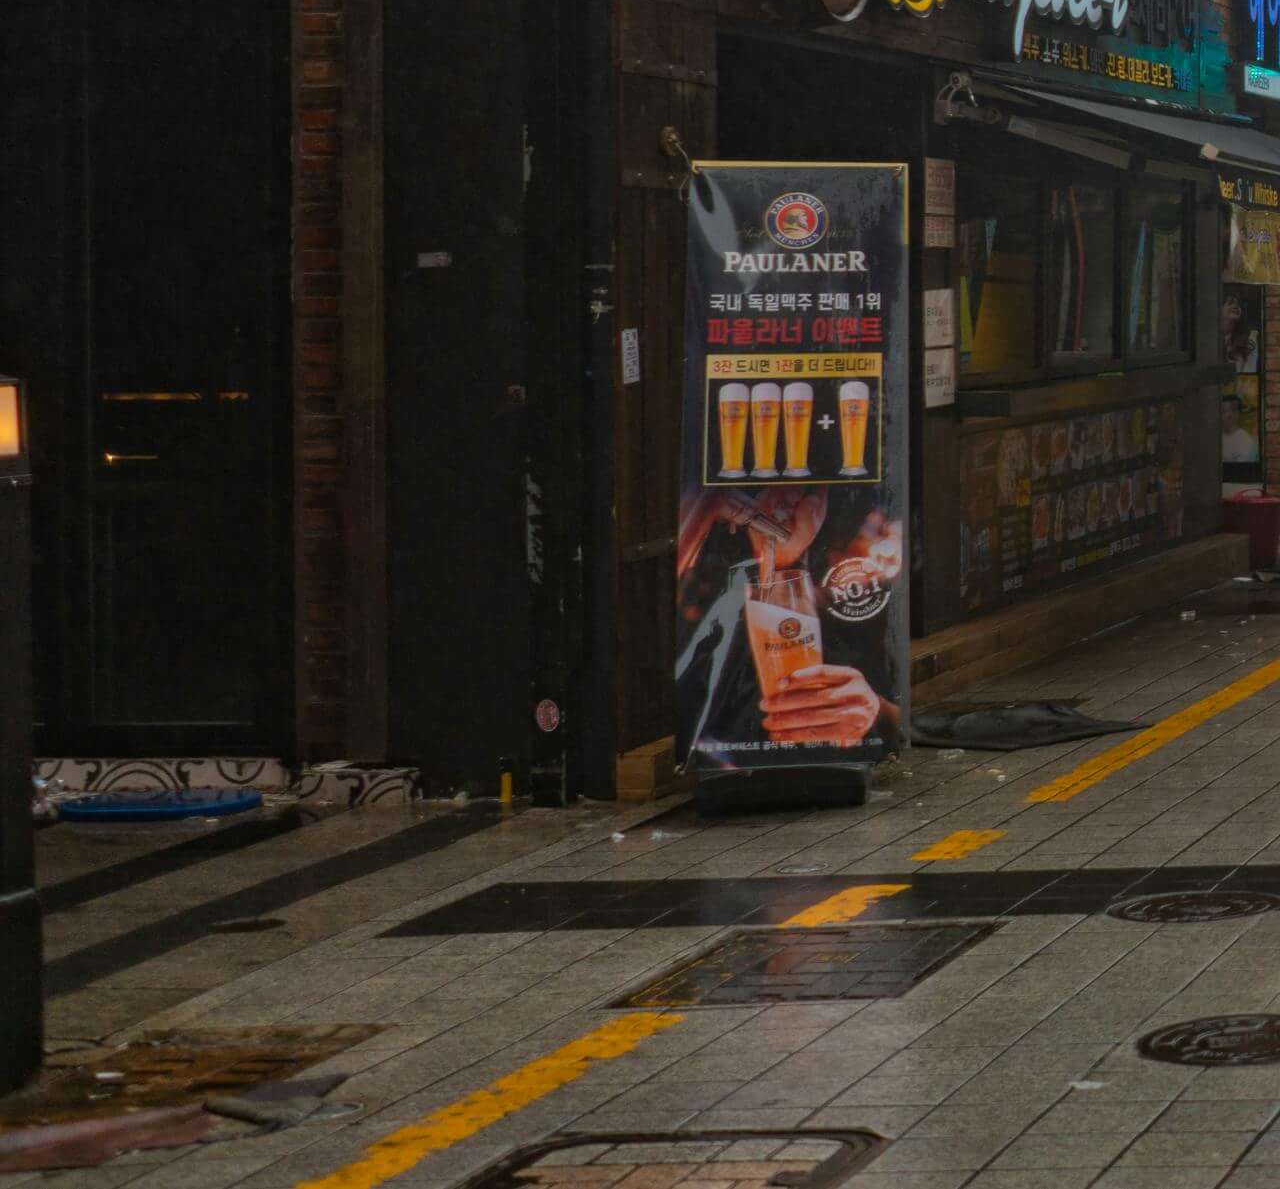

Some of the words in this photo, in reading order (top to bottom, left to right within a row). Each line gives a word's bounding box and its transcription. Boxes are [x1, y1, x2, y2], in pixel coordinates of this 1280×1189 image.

[723, 250, 868, 274] PAULANER
[709, 293, 742, 312] 국내
[747, 292, 813, 312] 독일맥주
[818, 292, 850, 312] 판매
[856, 292, 882, 311] 1위
[706, 318, 804, 346] 파울라너
[811, 317, 883, 344] 이벤트
